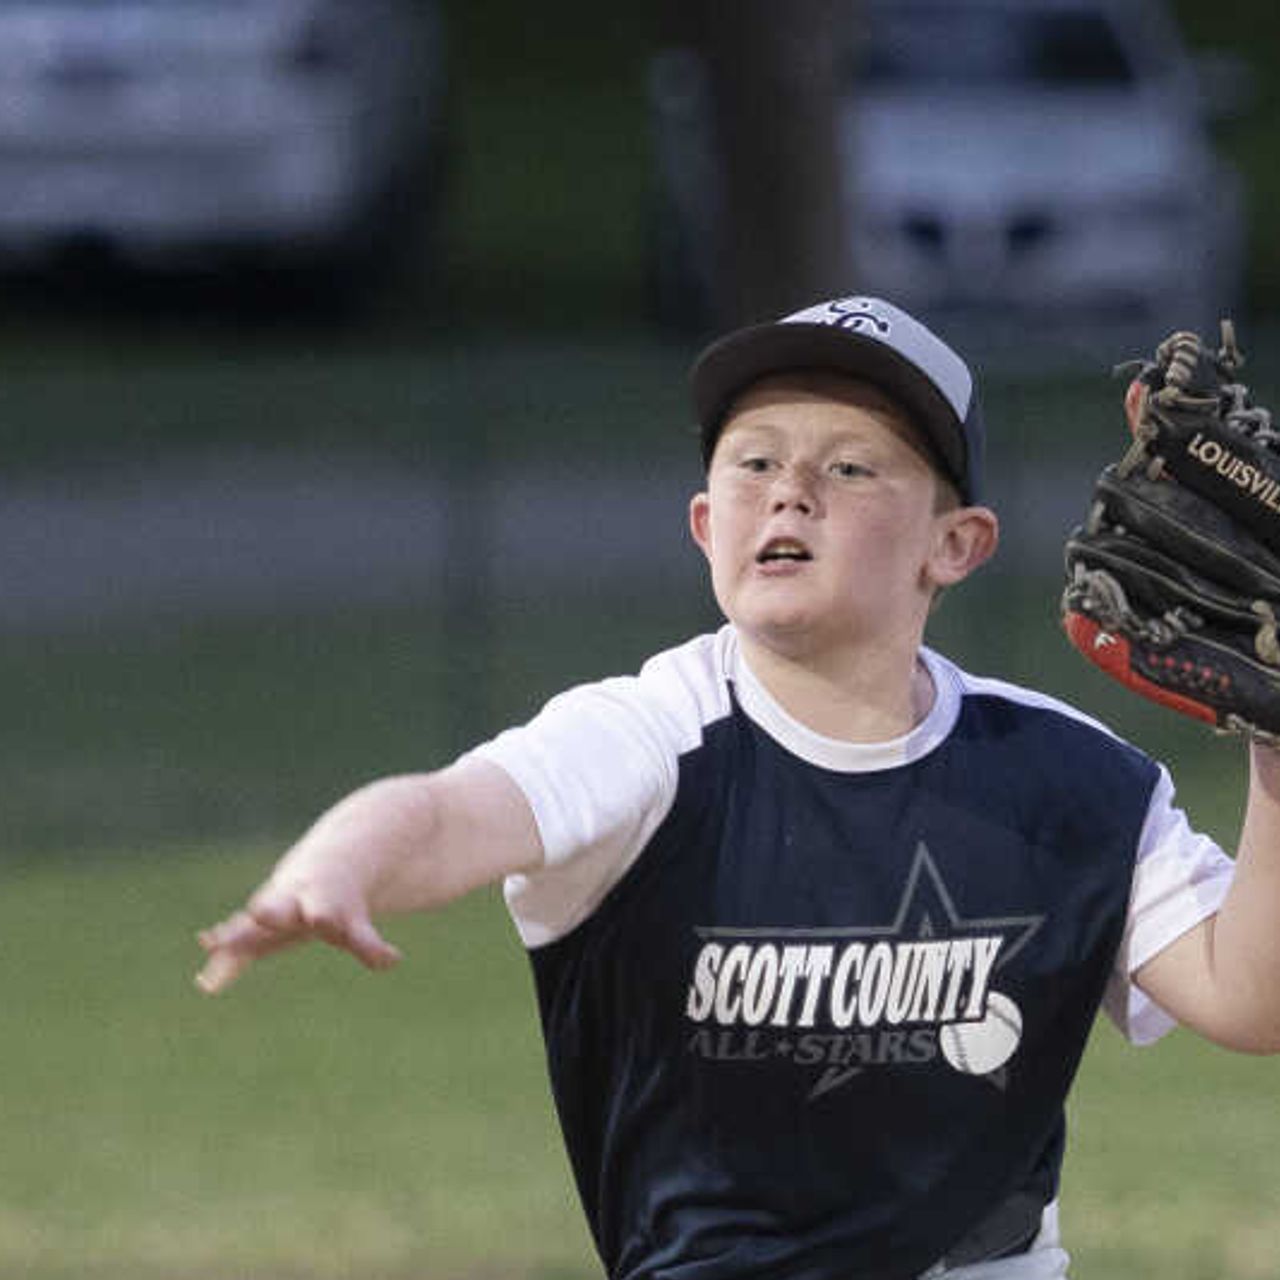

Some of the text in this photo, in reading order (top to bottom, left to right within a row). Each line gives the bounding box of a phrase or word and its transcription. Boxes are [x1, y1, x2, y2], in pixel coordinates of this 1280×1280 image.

[687, 936, 1004, 1029] SCOTT COUNTY
[793, 1029, 938, 1065] STARS
